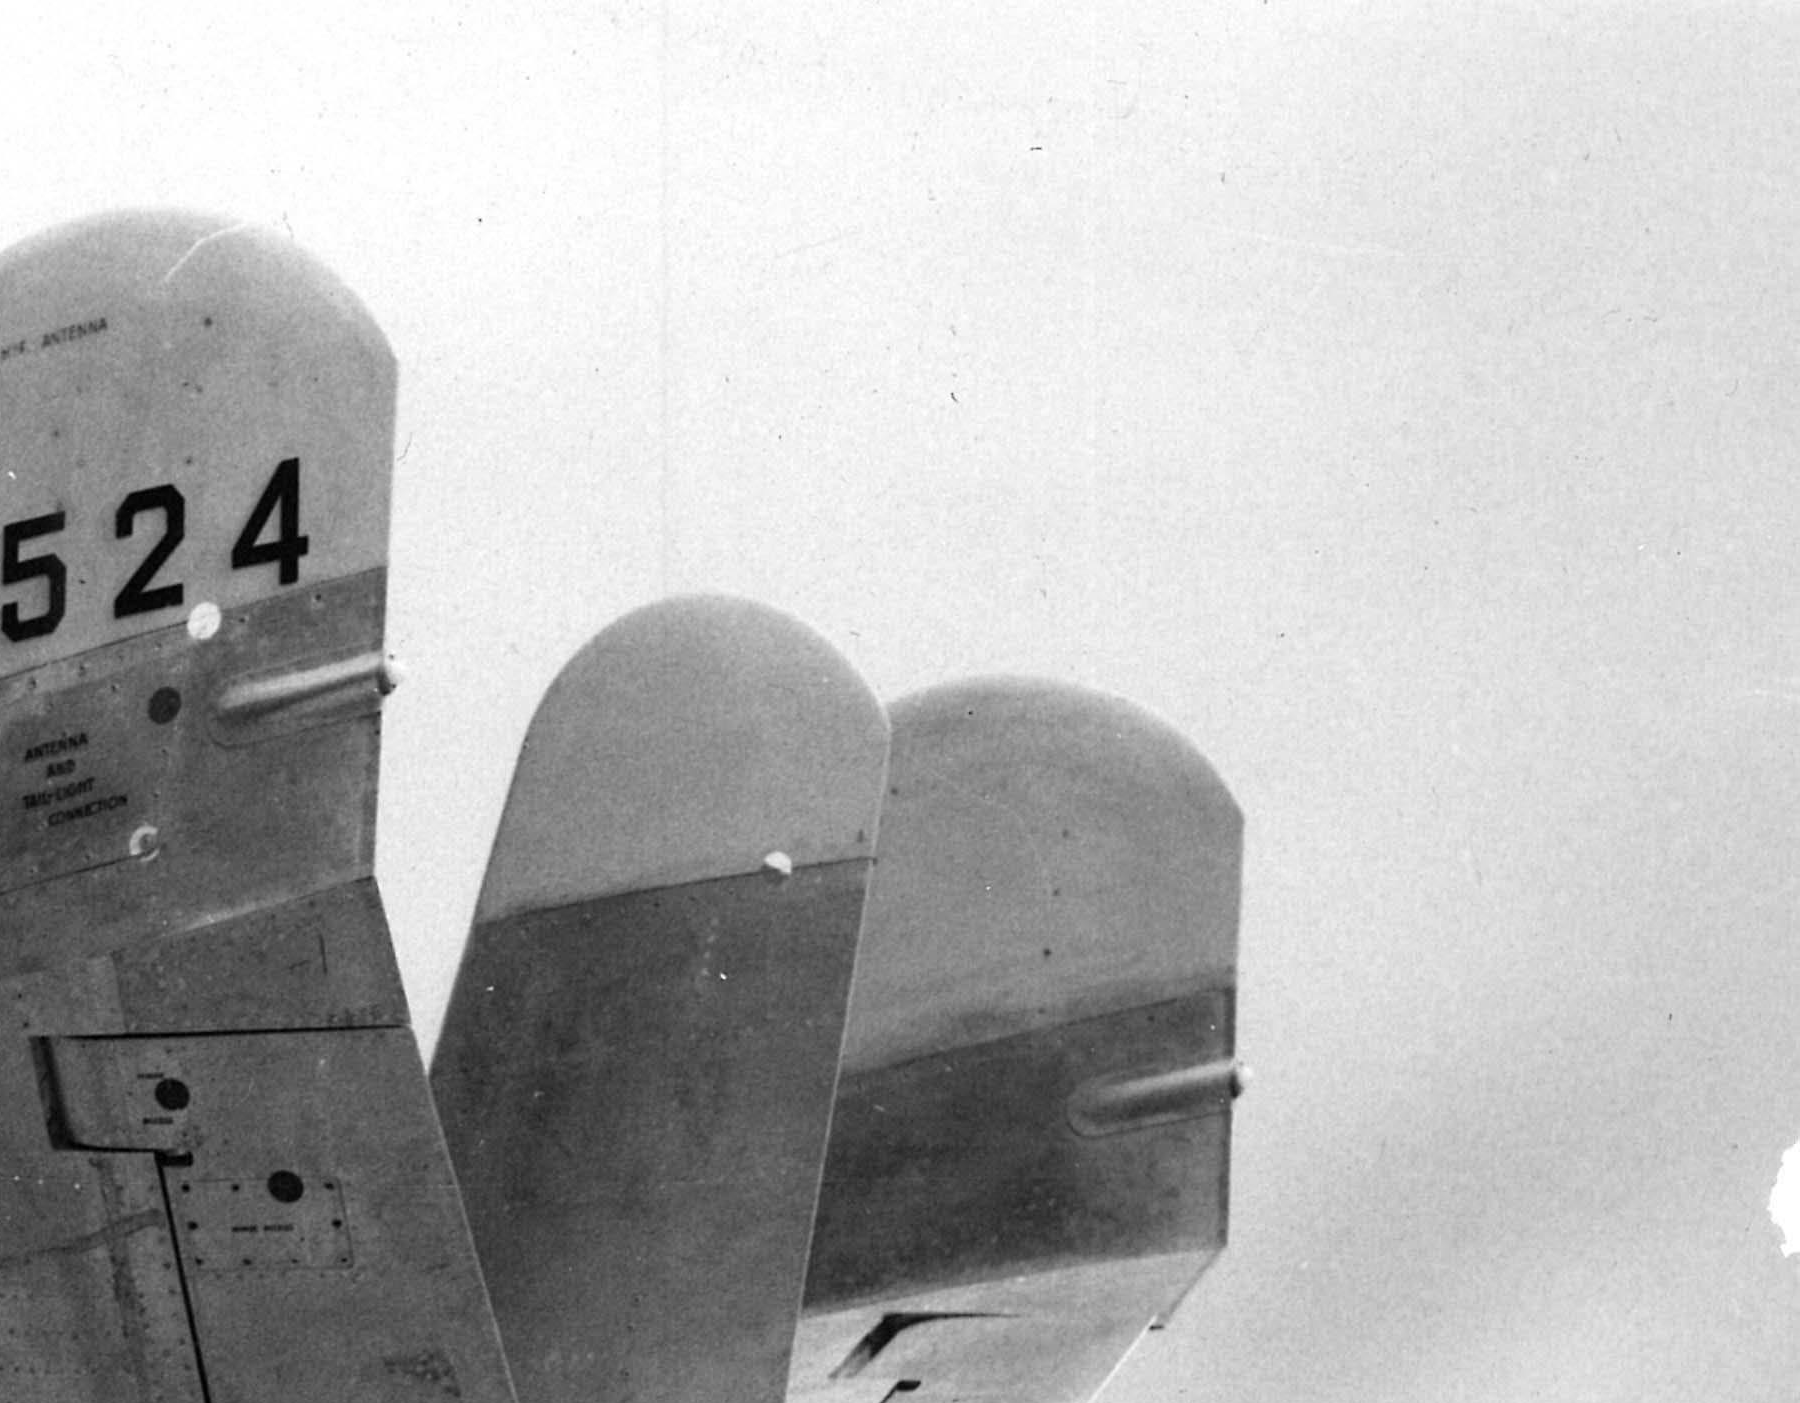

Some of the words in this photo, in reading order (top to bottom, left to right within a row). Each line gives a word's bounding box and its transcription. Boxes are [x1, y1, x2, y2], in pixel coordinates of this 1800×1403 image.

[41, 318, 108, 348] ANTENNA
[24, 732, 89, 763] ANTENNA
[46, 759, 76, 778] AND
[48, 794, 128, 826] CONNECTION
